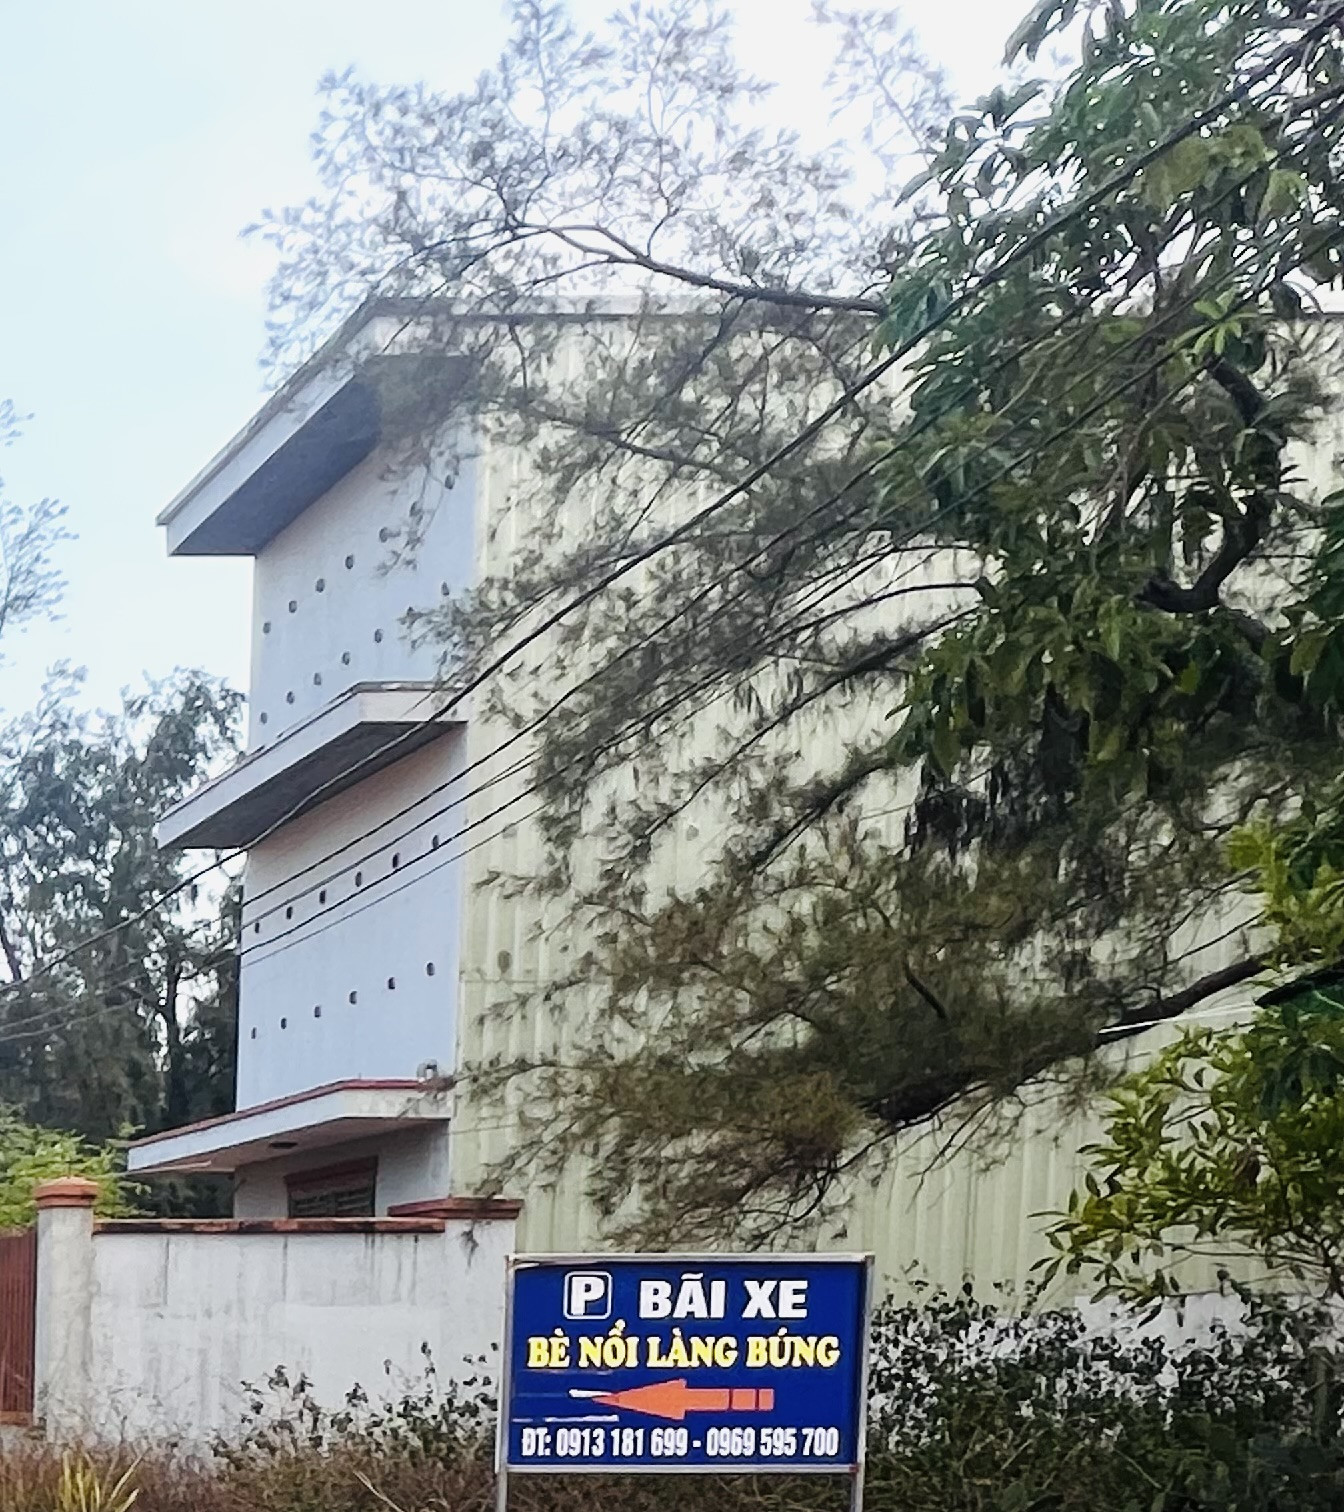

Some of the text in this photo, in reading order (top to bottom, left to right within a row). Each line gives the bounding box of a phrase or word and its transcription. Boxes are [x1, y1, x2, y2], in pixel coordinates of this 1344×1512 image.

[568, 1272, 809, 1319] P BÃI XE
[526, 1328, 571, 1368] BÈ
[647, 1328, 738, 1368] LÀNG
[745, 1327, 841, 1368] BÚNG
[522, 1428, 552, 1456] ĐT:
[556, 1428, 605, 1456] 0913
[611, 1428, 644, 1456] 181
[650, 1428, 688, 1456] 699
[706, 1428, 756, 1456] 0969
[760, 1428, 797, 1456] 595
[802, 1428, 839, 1456] 700
